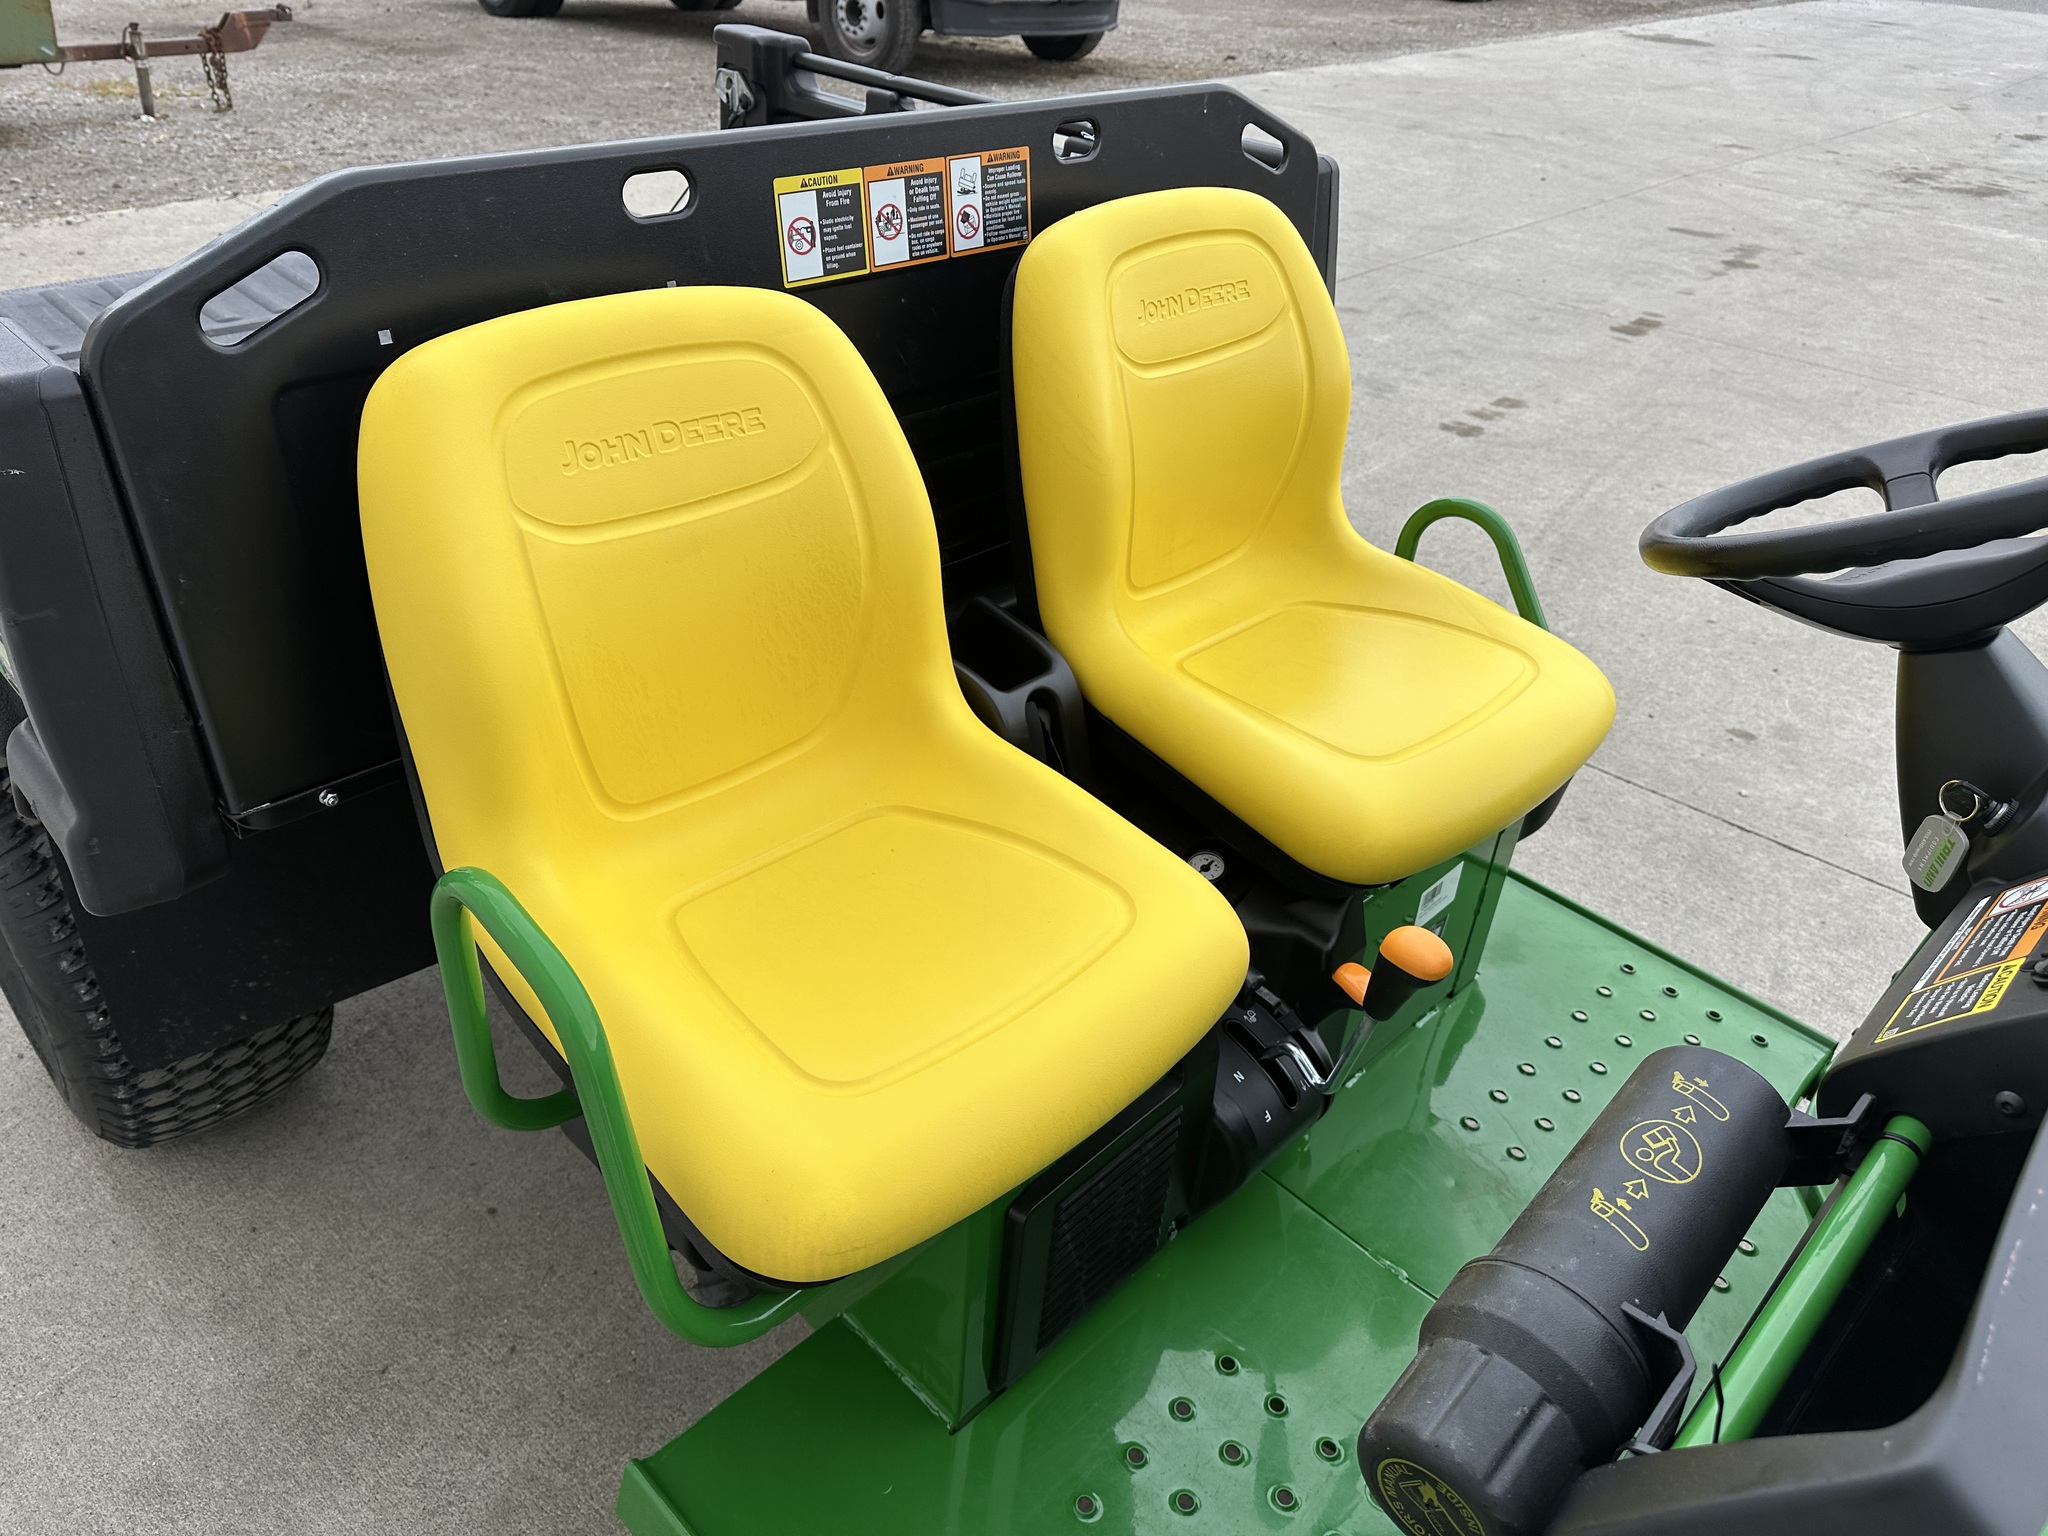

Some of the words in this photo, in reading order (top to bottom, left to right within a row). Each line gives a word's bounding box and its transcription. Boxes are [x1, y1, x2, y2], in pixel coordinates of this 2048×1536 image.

[993, 151, 1020, 162] WARNING
[894, 164, 924, 175] WARNING
[808, 175, 838, 187] CAUTION
[924, 177, 937, 185] Injury
[823, 190, 837, 198] Avoid
[913, 195, 929, 203] Falling
[911, 222, 928, 230] passenger
[845, 242, 863, 250] container
[832, 253, 845, 261] ground
[1137, 294, 1184, 326] JOHN
[1185, 280, 1250, 313] DEERE
[561, 430, 653, 476] JOHN
[652, 407, 767, 454] DEERE
[1918, 836, 1940, 871] EQUIPMENT
[1977, 970, 2012, 1008] CAUTION
[1233, 1070, 1245, 1083] N
[1264, 1110, 1272, 1123] F
[1383, 1464, 1413, 1498] MANUAL
[1436, 1482, 1480, 1534] INSIDE
